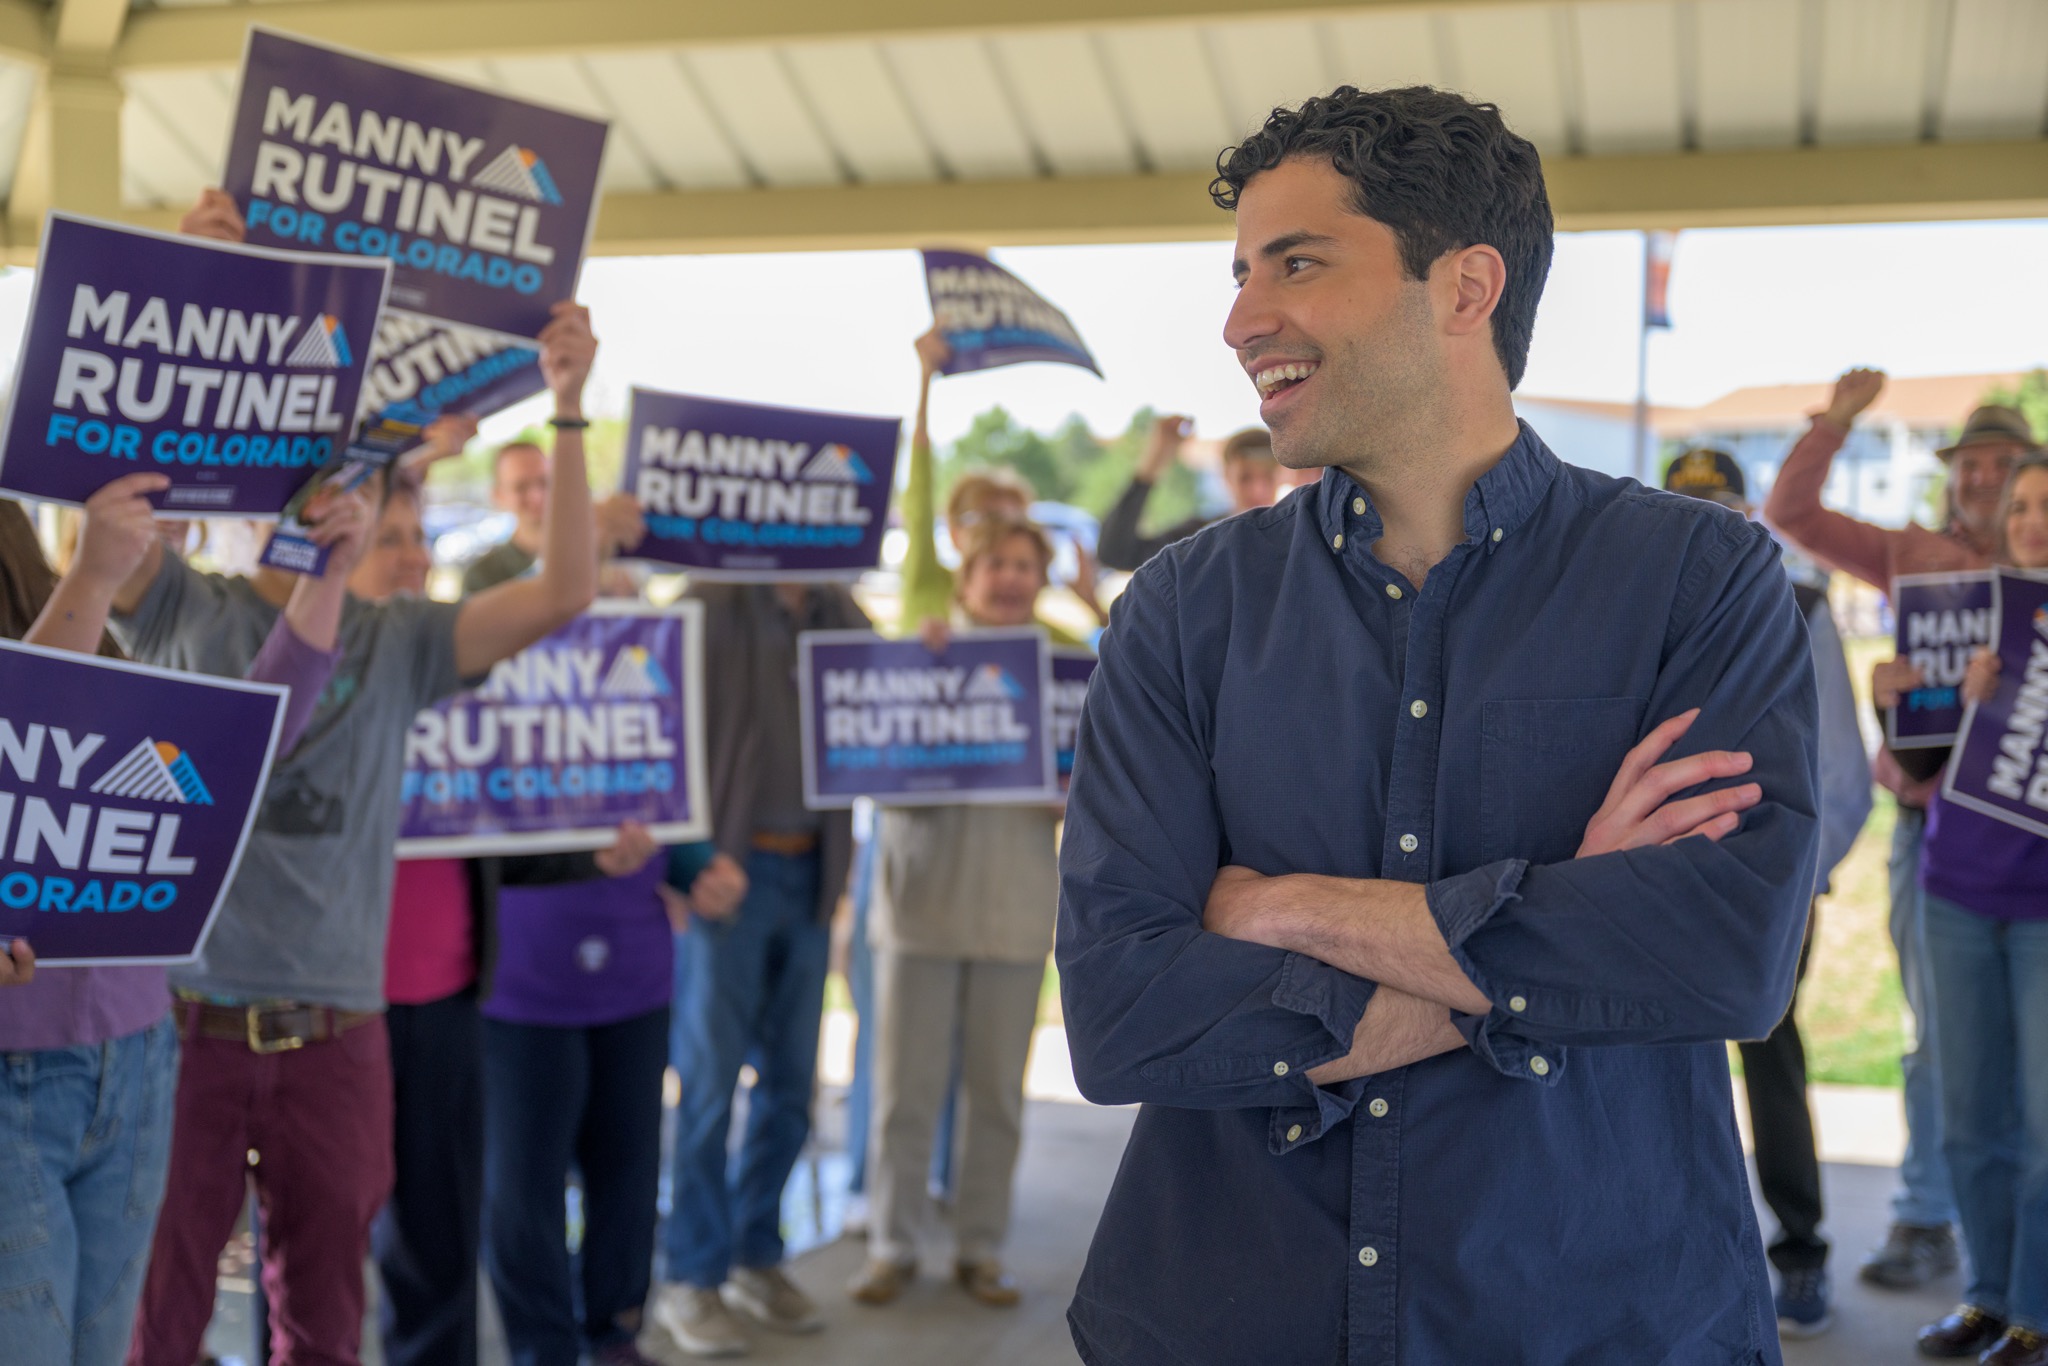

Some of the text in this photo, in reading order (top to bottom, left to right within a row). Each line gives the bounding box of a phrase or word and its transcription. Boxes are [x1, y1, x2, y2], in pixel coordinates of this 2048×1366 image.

[262, 86, 485, 182] MANNY
[250, 140, 555, 265] RUTINEL
[246, 200, 543, 295] FOR COLORADO
[67, 283, 301, 366] MANNY
[52, 347, 343, 433] RUTINEL
[46, 413, 139, 460] FOR
[150, 432, 332, 467] COLORADO
[640, 424, 811, 482] MANNY
[638, 468, 872, 526] RUTINEL
[404, 703, 675, 767] RUTINEL
[825, 701, 1030, 747] RUTINEL
[401, 760, 674, 805] FOR COLORADO
